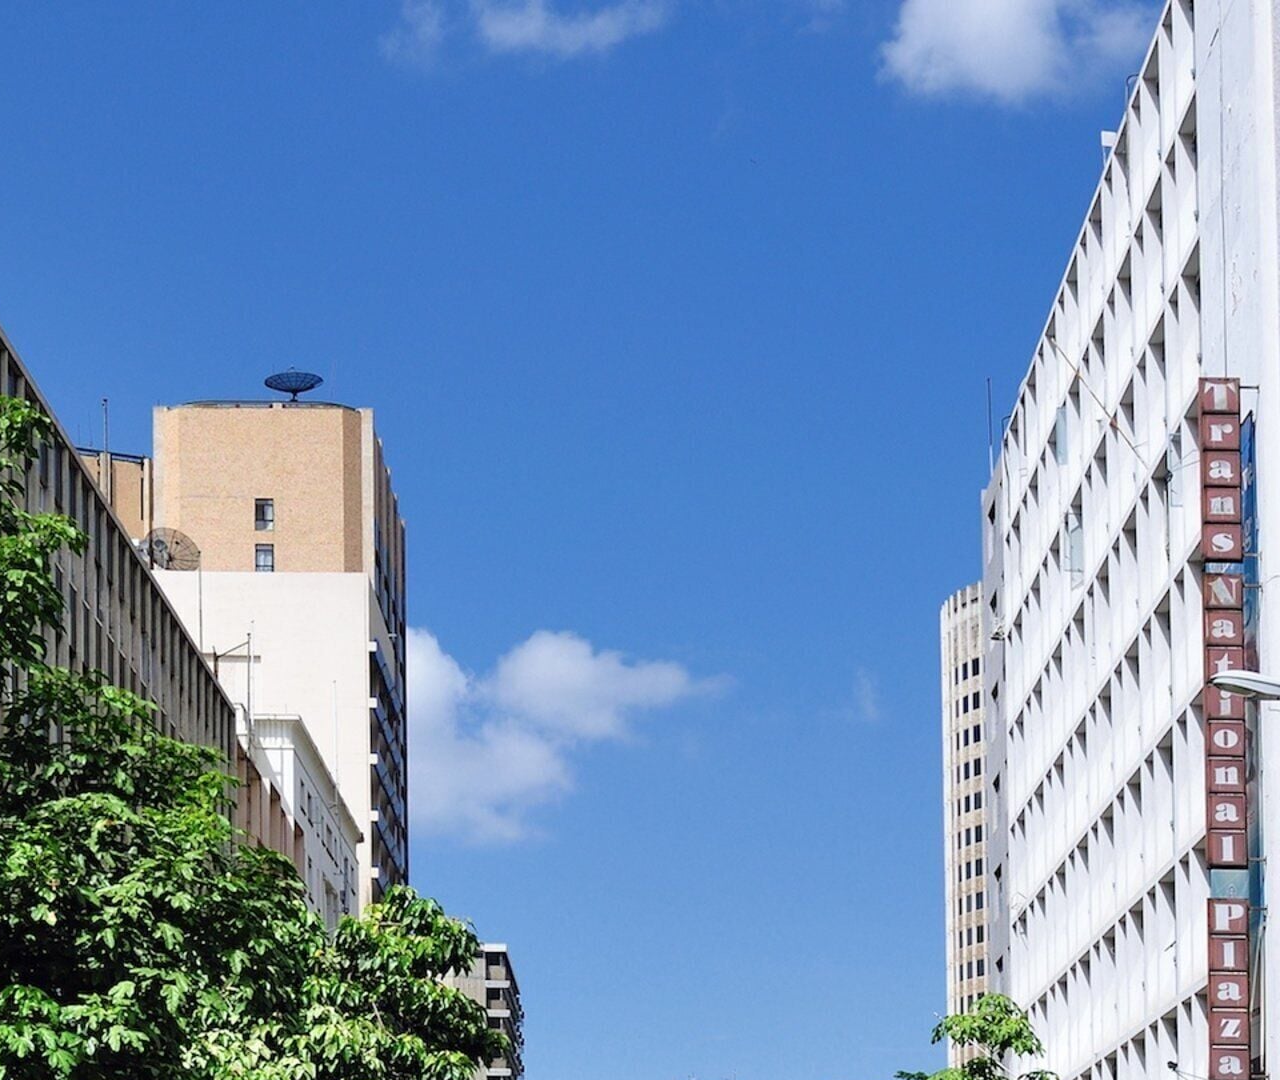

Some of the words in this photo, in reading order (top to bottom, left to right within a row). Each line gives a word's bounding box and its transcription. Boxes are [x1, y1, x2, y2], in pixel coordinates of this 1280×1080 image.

[1204, 381, 1238, 552] Trans
[1207, 577, 1240, 862] National
[1213, 903, 1243, 1075] Plaza
